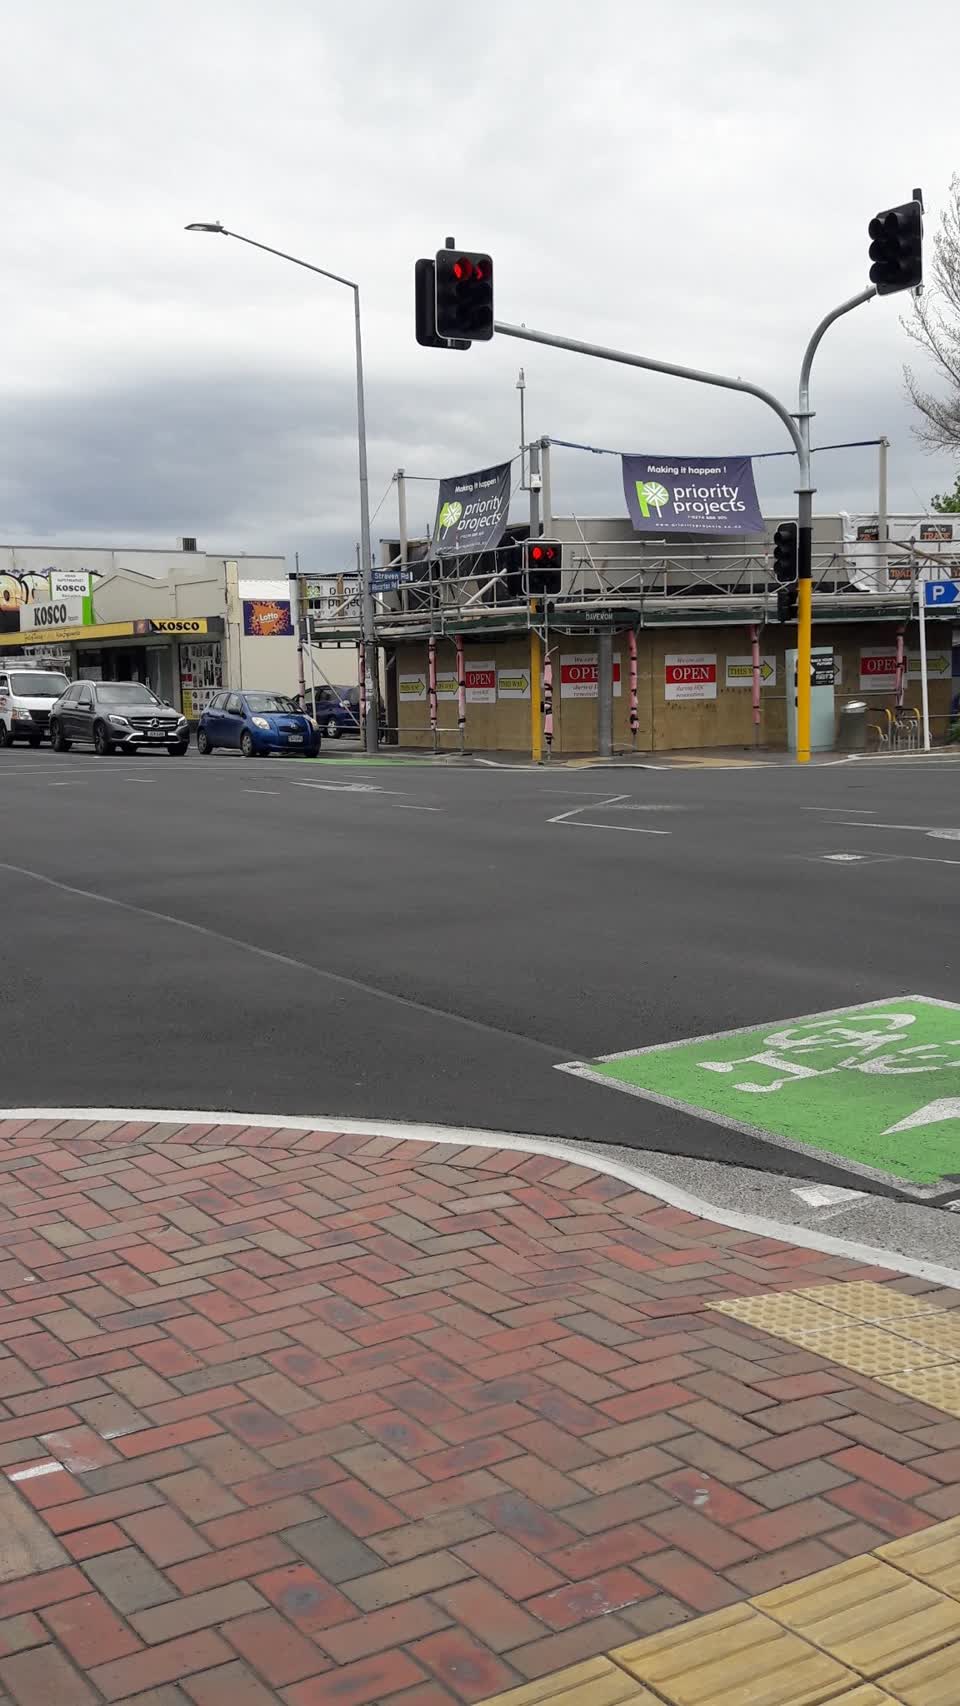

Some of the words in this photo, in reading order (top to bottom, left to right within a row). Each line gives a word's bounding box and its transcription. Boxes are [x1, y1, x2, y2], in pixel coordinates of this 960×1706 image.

[647, 465, 679, 475] Making
[688, 466, 721, 475] happen
[455, 484, 474, 493] Making
[479, 478, 497, 489] happen
[673, 484, 739, 502] priority
[463, 495, 503, 519] priority
[673, 499, 746, 515] projects
[457, 513, 502, 532] projects
[56, 584, 87, 592] KOSCO
[932, 585, 945, 601] P
[33, 604, 67, 626] KOSCO
[258, 612, 279, 622] Lotto
[159, 621, 200, 631] KOSCO
[730, 667, 748, 675] THIS
[867, 659, 899, 672] OPEN
[469, 673, 491, 685] OPEN
[569, 667, 599, 680] OPE
[672, 667, 710, 680] OPEN
